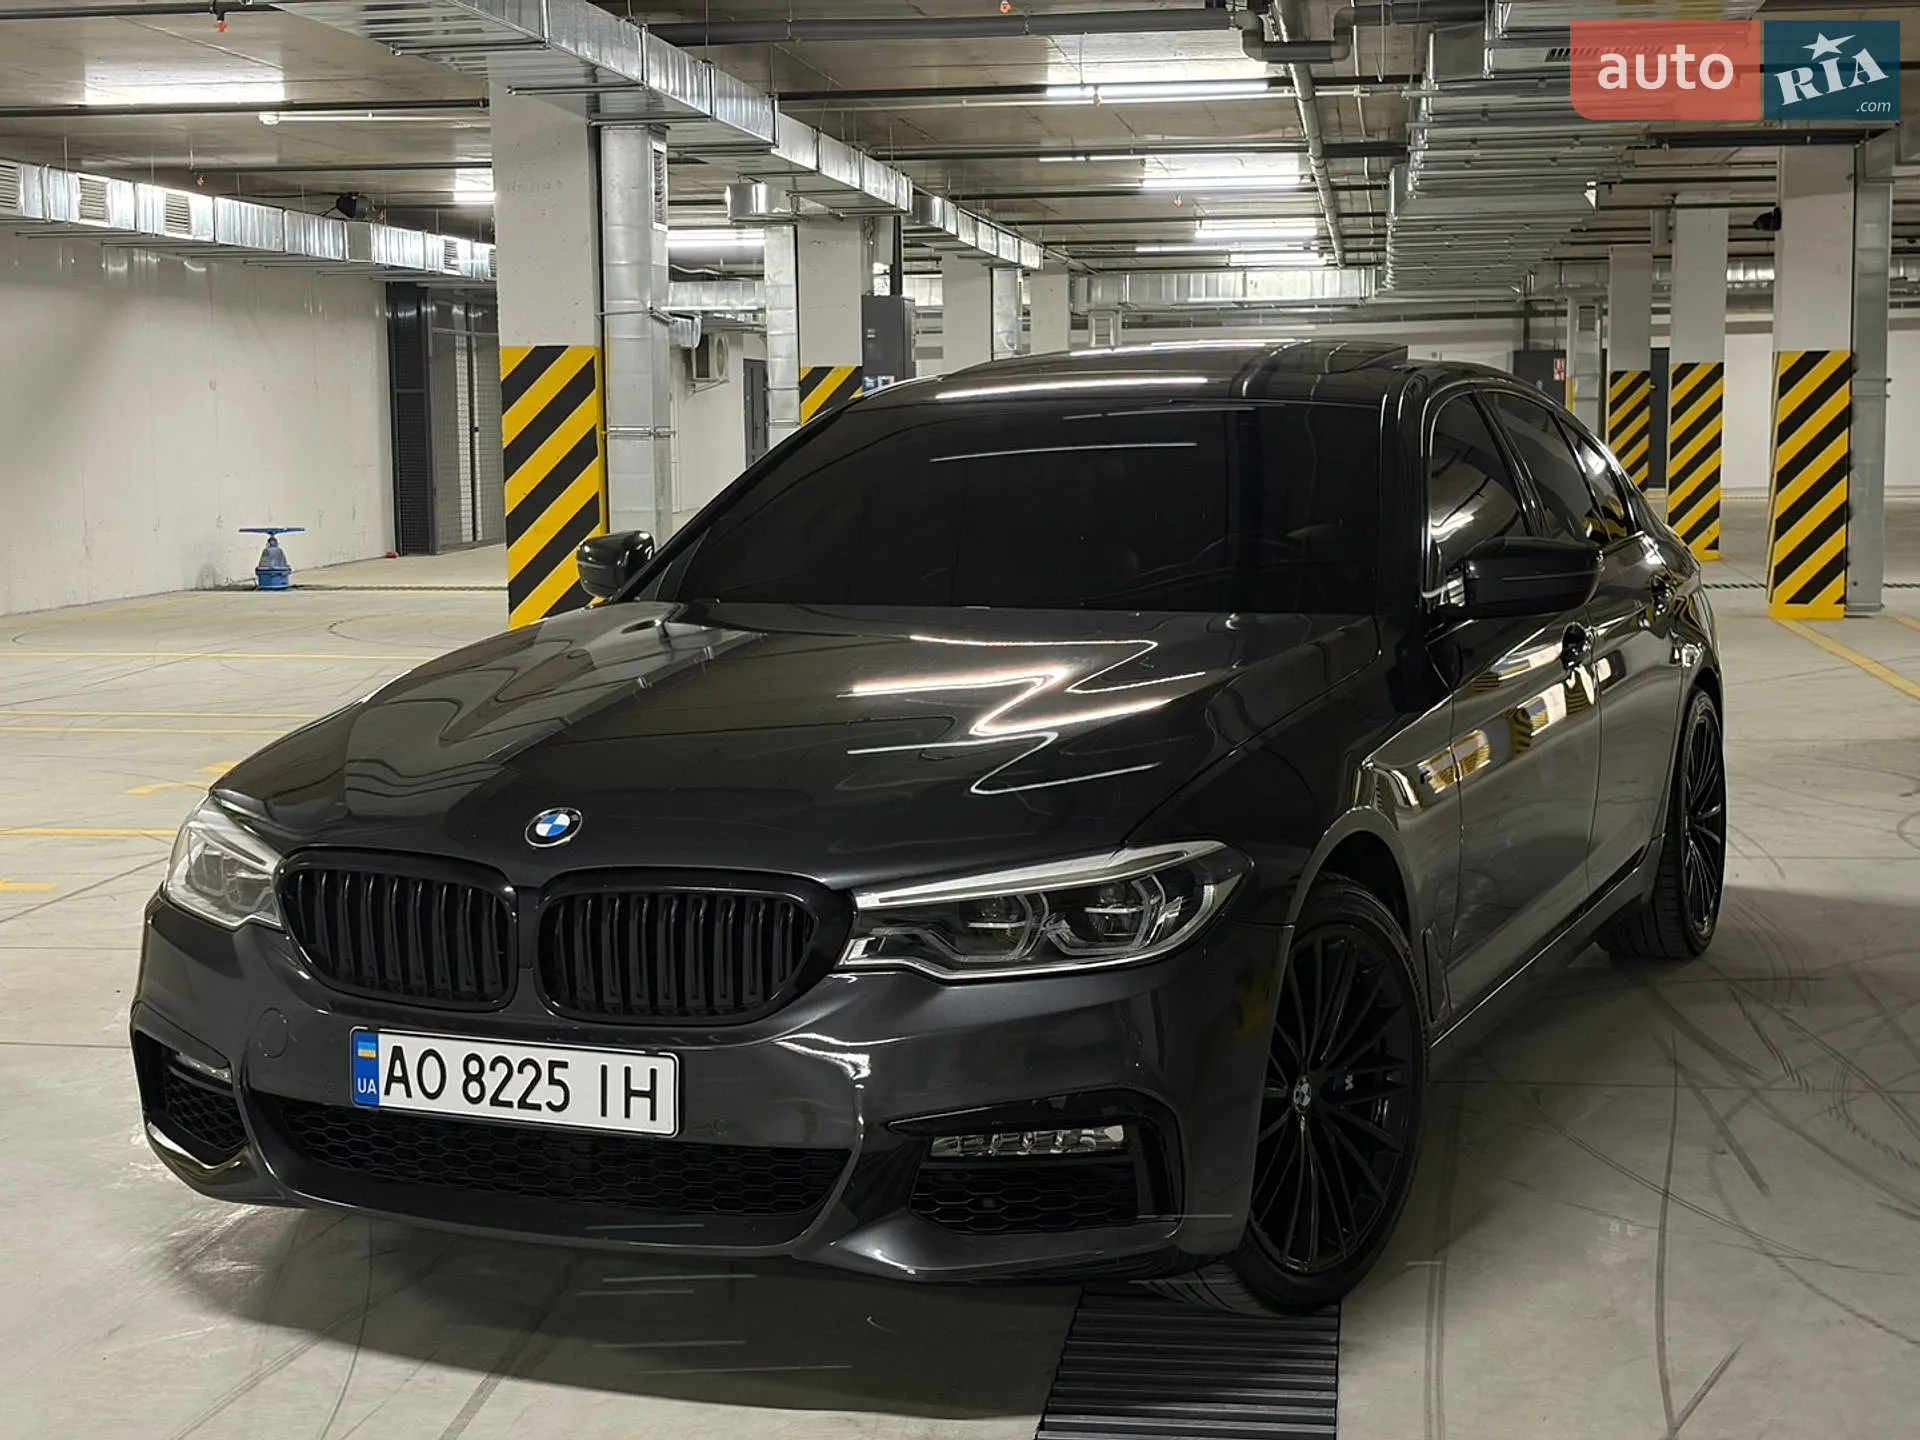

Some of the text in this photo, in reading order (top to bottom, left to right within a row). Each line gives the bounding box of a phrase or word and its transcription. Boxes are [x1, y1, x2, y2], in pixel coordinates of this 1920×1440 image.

[357, 1077, 378, 1095] UA
[384, 1045, 658, 1122] AO 8225 IH
